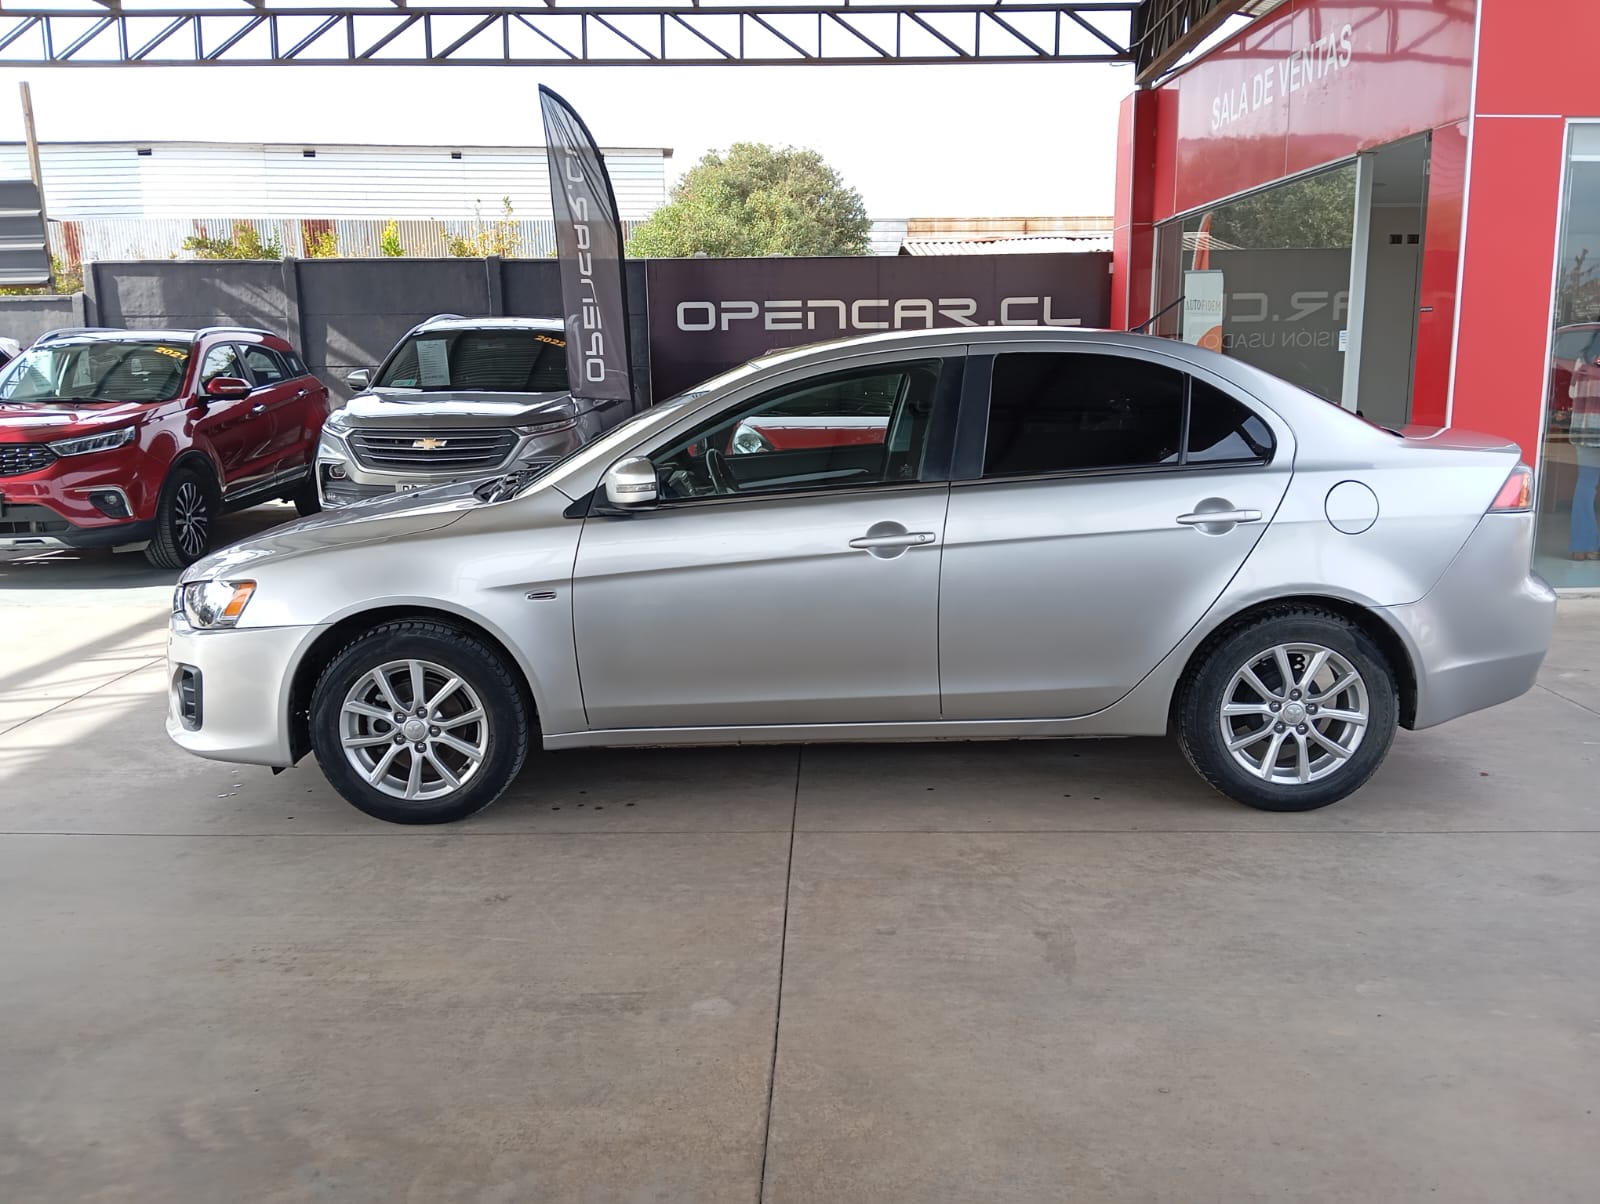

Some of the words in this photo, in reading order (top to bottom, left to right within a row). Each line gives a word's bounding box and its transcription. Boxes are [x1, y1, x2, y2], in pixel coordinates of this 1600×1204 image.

[1211, 82, 1249, 130] SALA
[1252, 65, 1274, 111] DE
[1279, 23, 1352, 97] VENTAS
[676, 296, 1082, 332] OPENCAR.CL
[154, 346, 189, 360] 2021
[534, 335, 567, 348] 2022
